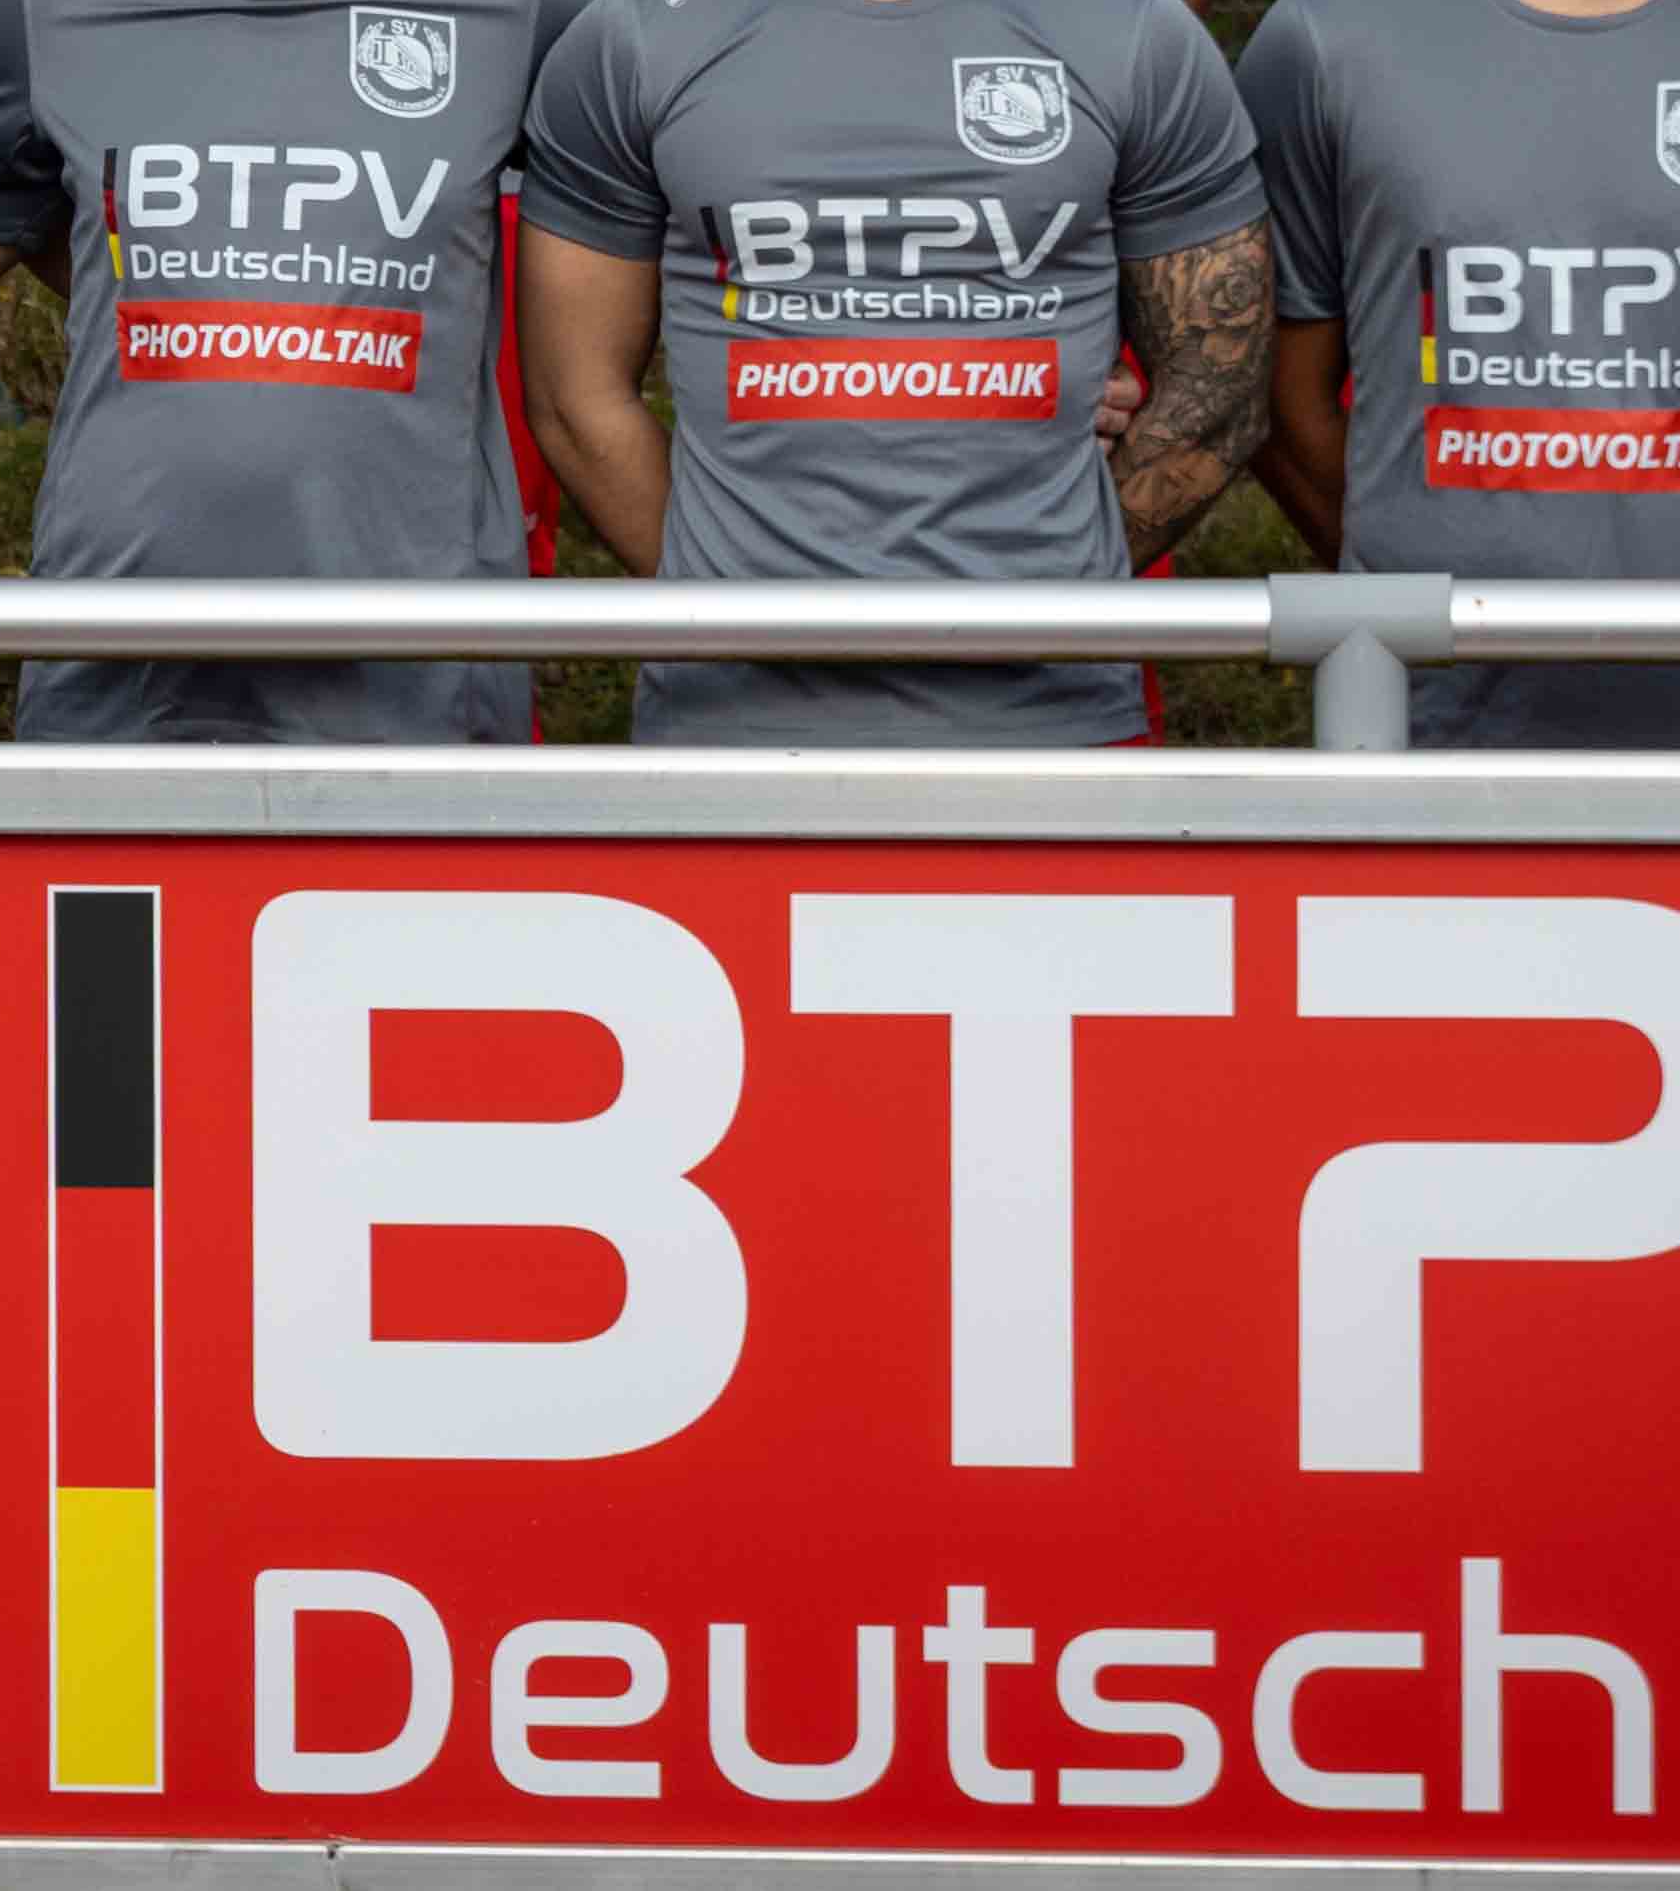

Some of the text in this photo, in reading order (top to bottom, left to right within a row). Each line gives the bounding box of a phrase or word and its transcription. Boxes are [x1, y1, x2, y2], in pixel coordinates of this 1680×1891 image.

[391, 19, 417, 36] SV
[995, 65, 1025, 84] SV
[127, 143, 450, 239] BTPV
[729, 197, 1079, 283] BTPV
[130, 242, 435, 291] Deutschland
[747, 280, 1063, 321] Deutschland
[129, 323, 410, 368] PHOTOVOLTAIK
[737, 361, 1049, 397] PHOTOVOLTAIK
